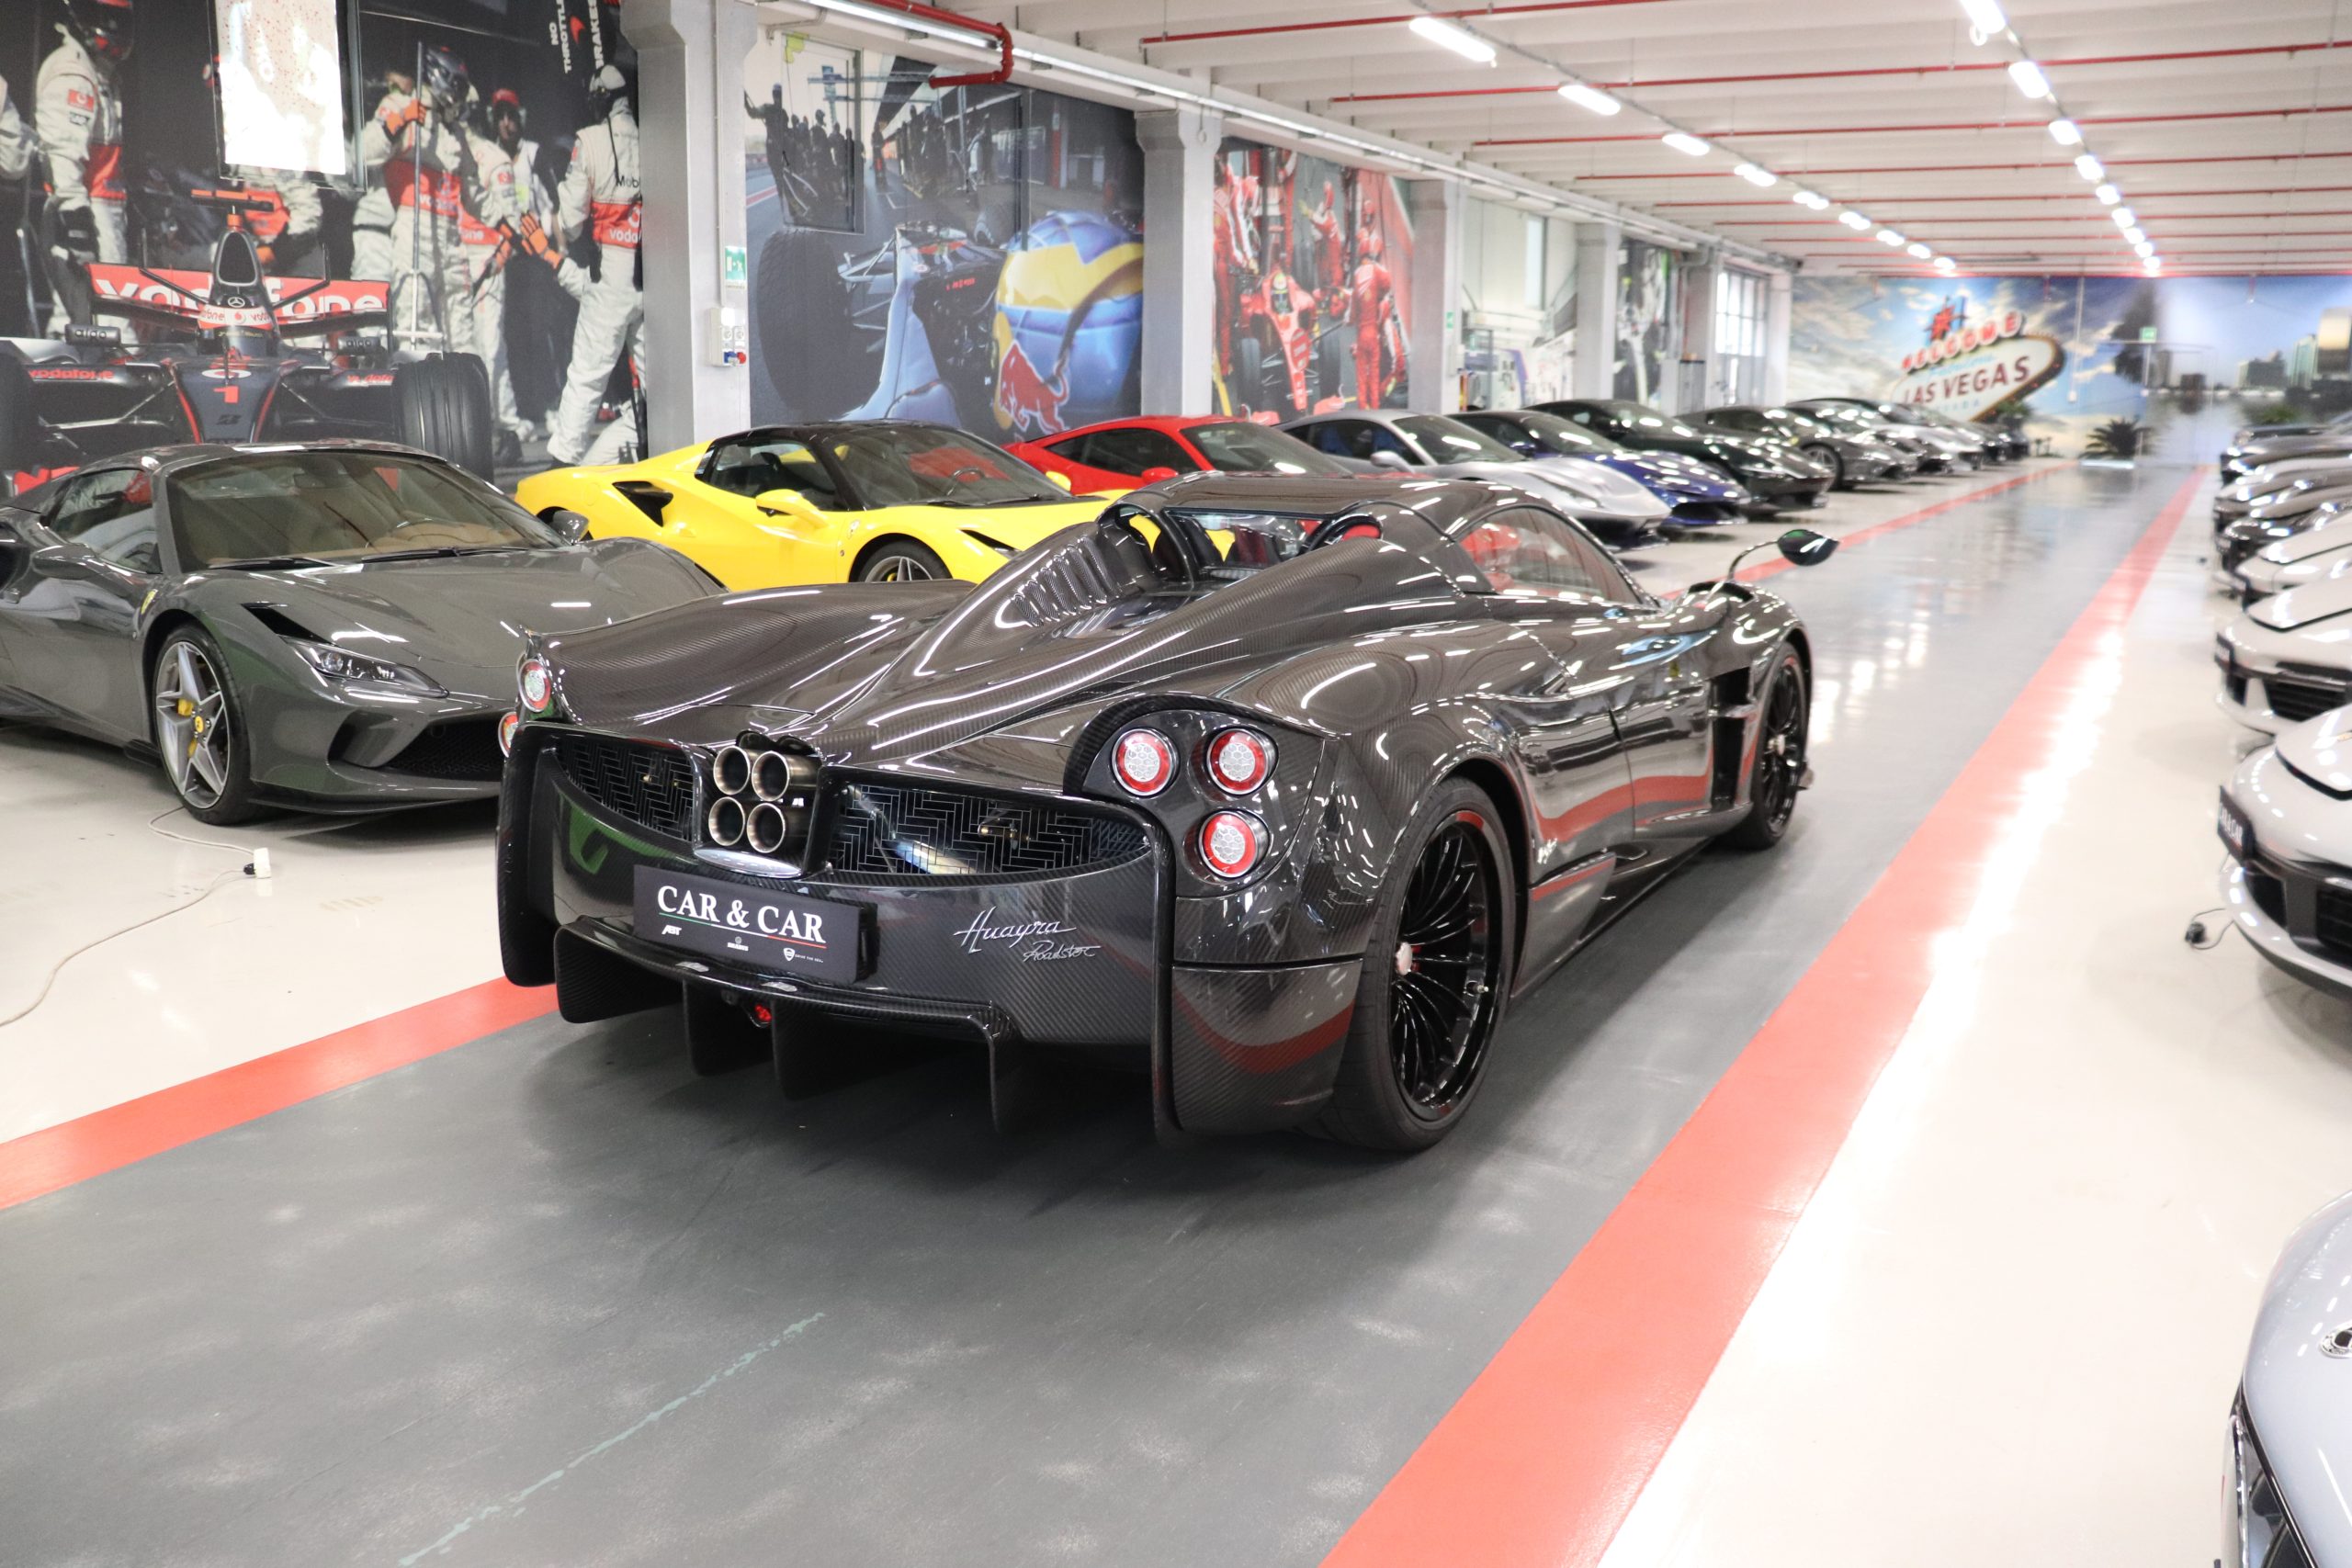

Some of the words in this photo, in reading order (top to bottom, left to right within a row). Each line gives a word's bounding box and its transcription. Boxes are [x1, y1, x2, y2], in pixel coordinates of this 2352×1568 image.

[549, 22, 560, 46] NO
[1943, 355, 2030, 399] VEGAS
[657, 886, 720, 923] CAR
[726, 899, 750, 929] &
[757, 906, 826, 943] CAR
[662, 925, 682, 935] ABT
[954, 906, 1078, 953] Huayra
[1022, 940, 1102, 963] Roadster
